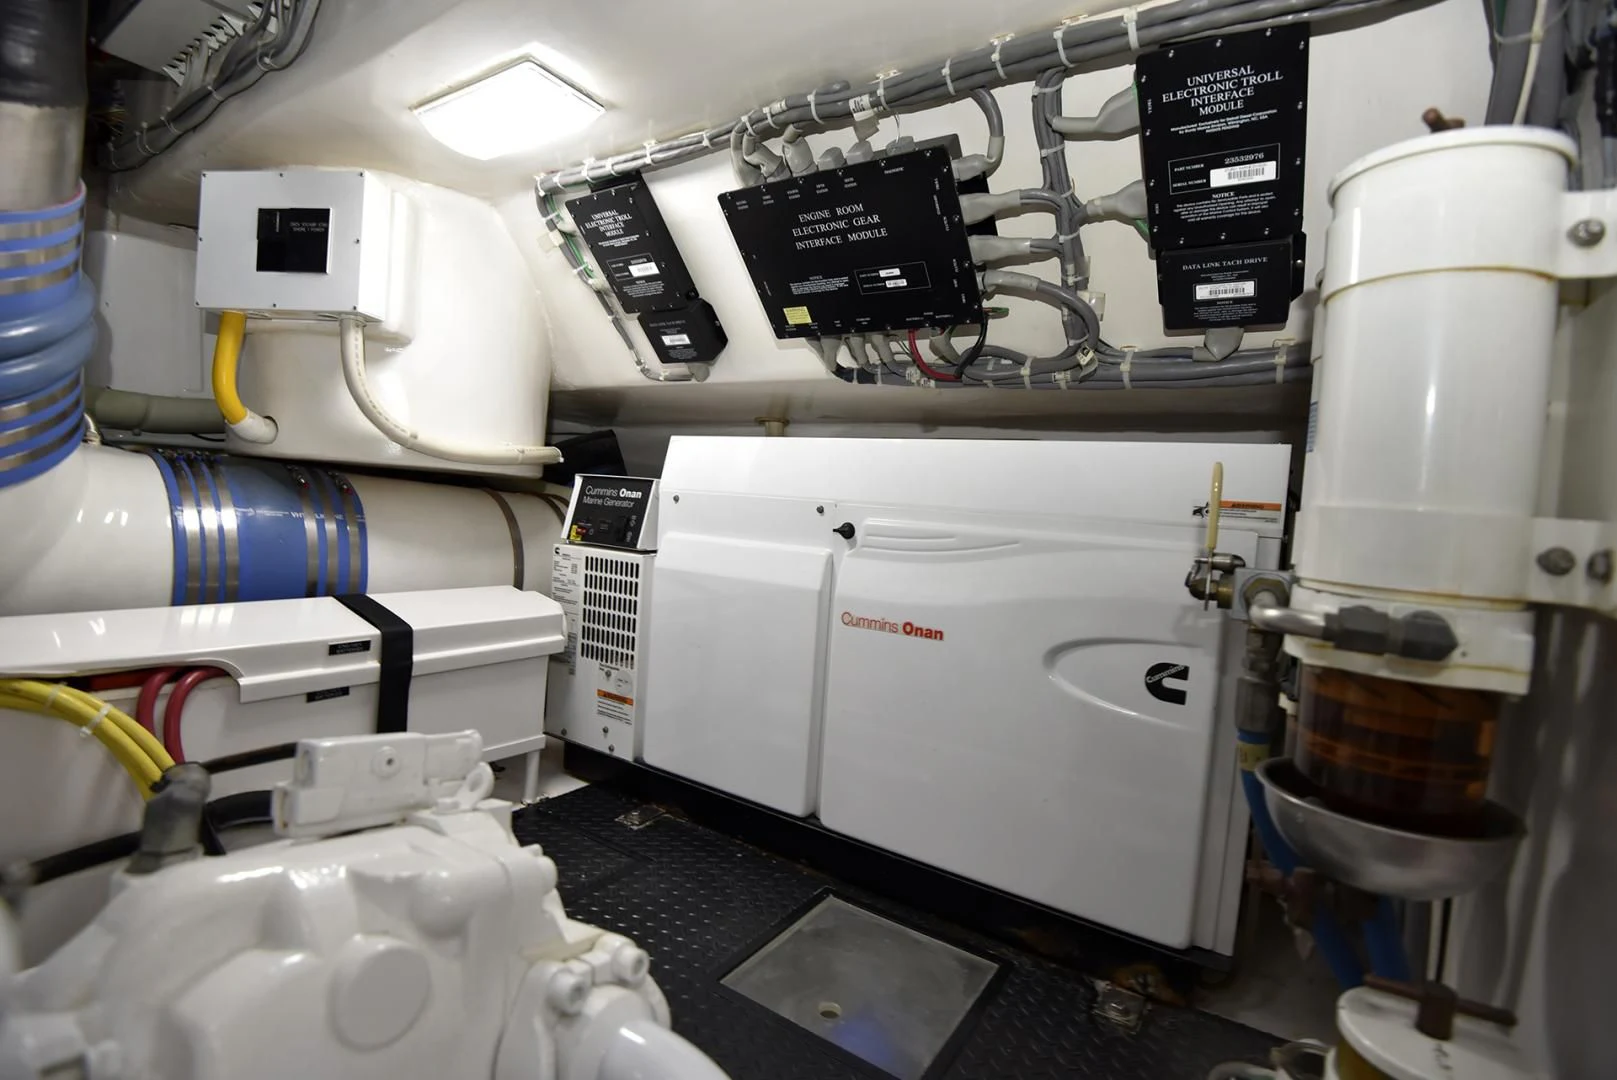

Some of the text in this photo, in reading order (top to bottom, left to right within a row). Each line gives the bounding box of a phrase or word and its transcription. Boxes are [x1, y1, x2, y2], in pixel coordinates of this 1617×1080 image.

[1187, 65, 1255, 87] UNIVERSAL
[1162, 70, 1284, 103] ELECTRONIC TROLL
[1191, 87, 1254, 107] INTERFACE
[1199, 100, 1244, 116] MODULE
[798, 203, 864, 223] ENGINE ROOM
[792, 214, 880, 237] ELECTRONIC GEAR
[796, 227, 888, 251] INTERFACE MODULE
[1182, 257, 1268, 271] DATA LINK TACH DRIVE
[582, 496, 635, 508] Marine Generator
[585, 485, 642, 499] Cummins Onan
[840, 611, 945, 641] Cummins Onan
[1145, 664, 1185, 685] Cummins
